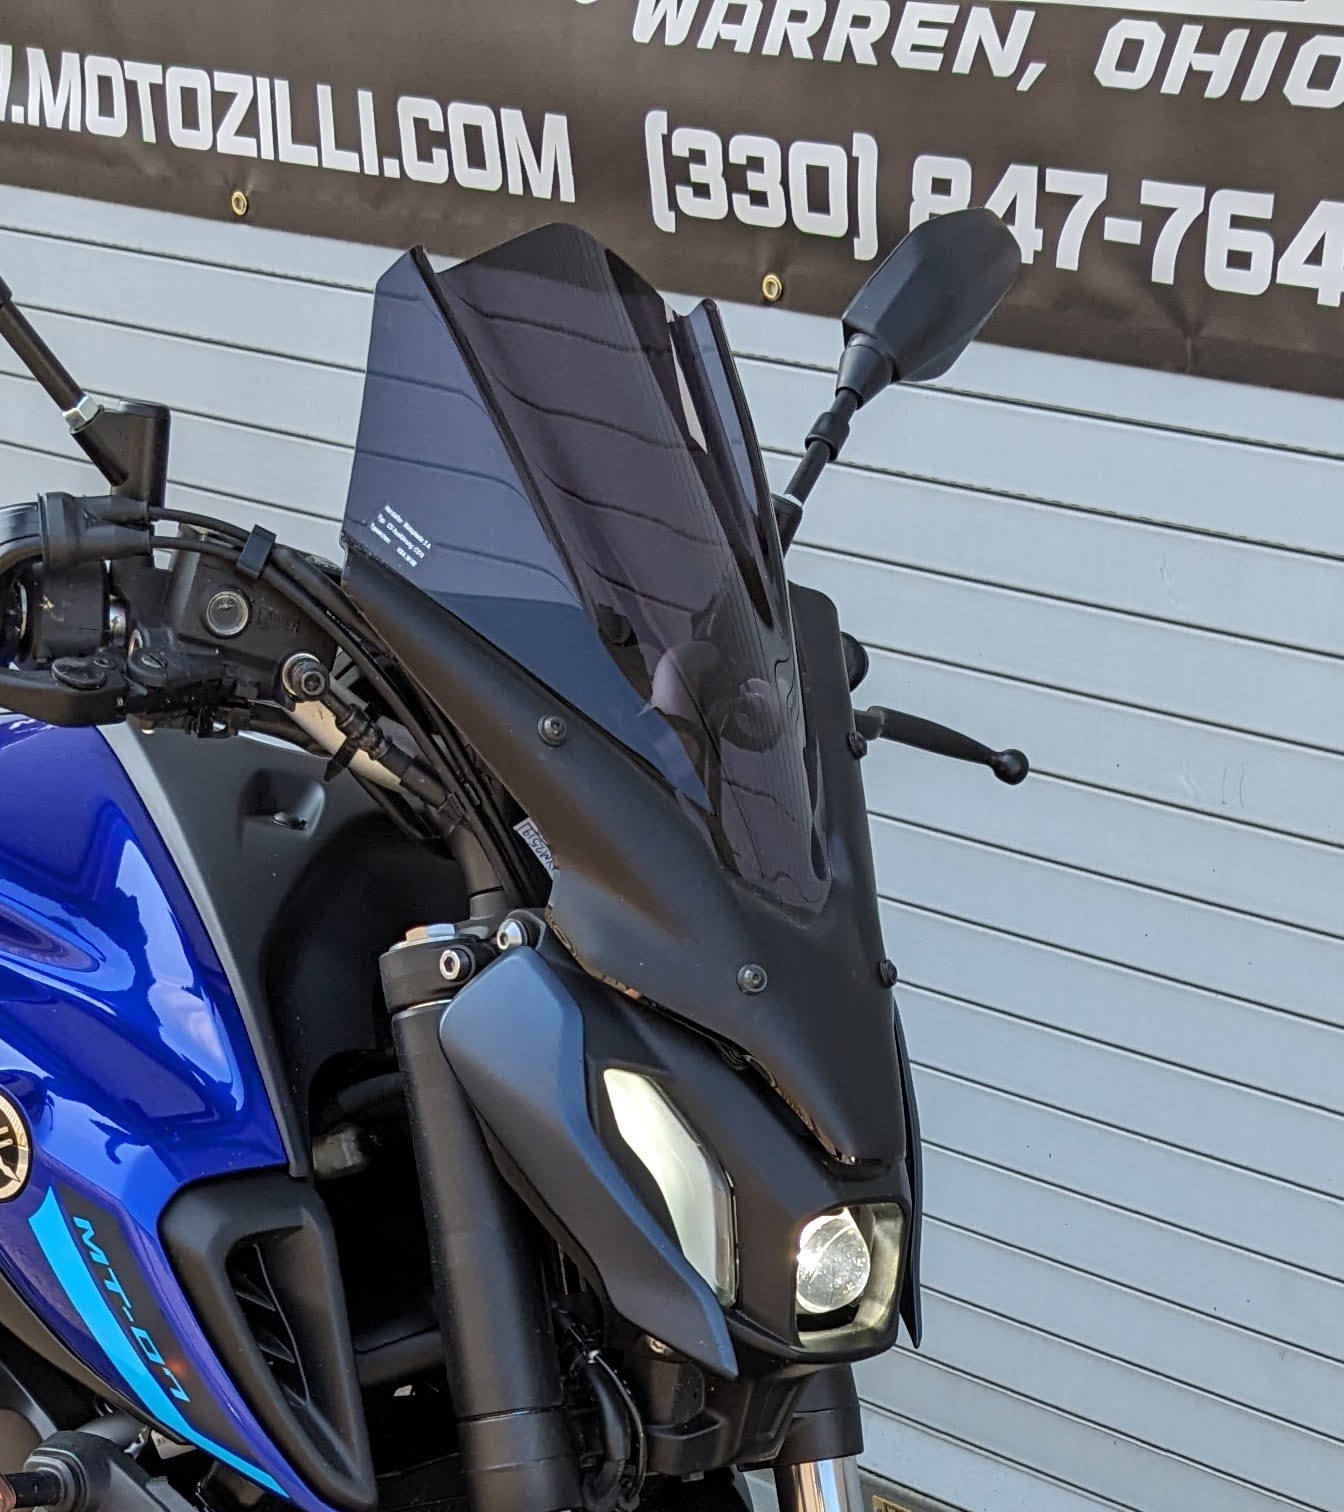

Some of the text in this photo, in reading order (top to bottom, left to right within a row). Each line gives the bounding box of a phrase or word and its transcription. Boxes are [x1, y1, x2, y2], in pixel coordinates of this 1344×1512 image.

[632, 0, 1047, 92] WARREN,
[644, 109, 878, 262] (330)
[72, 1215, 191, 1403] MT-07
